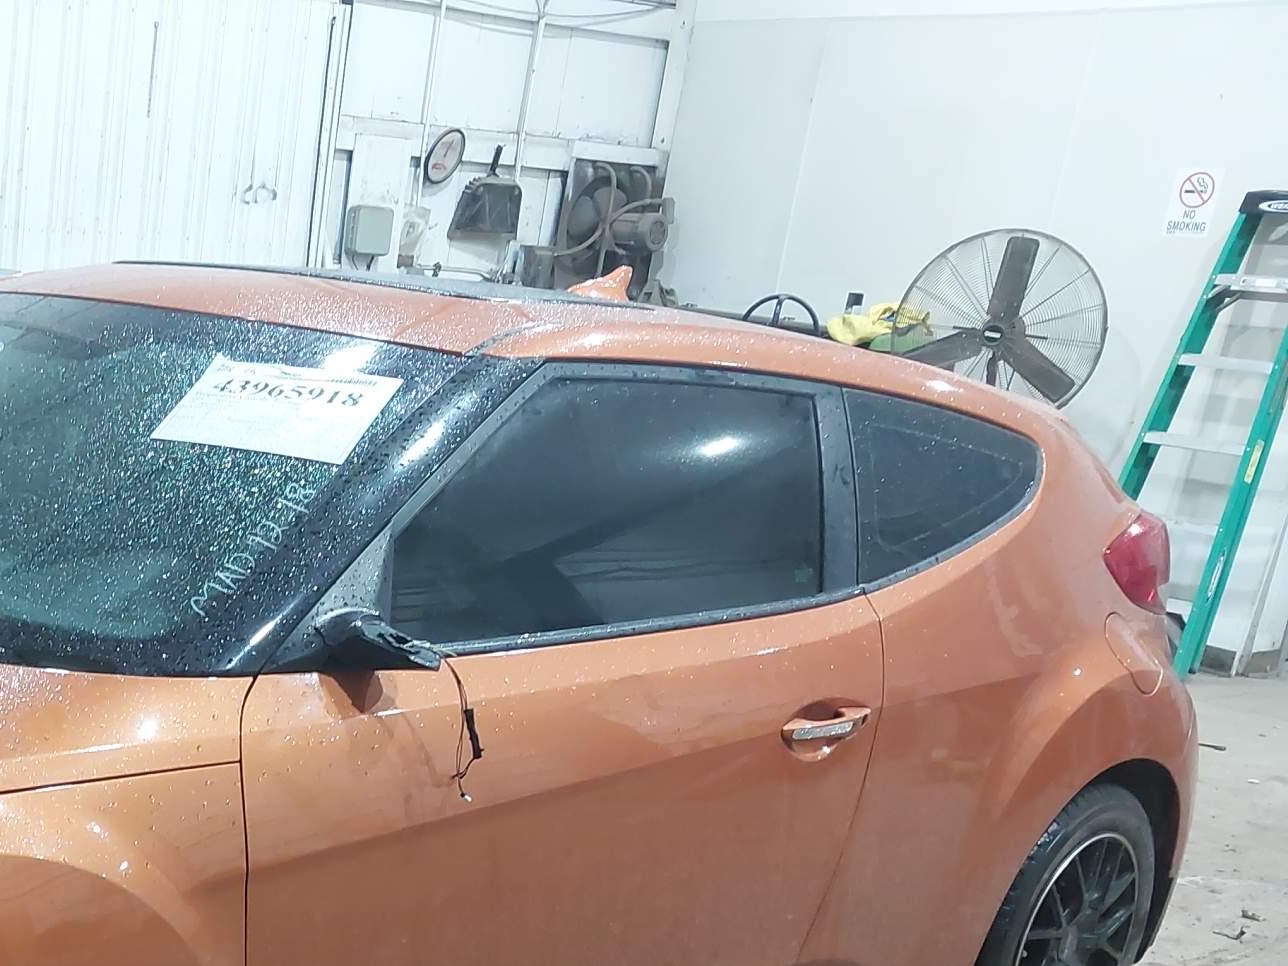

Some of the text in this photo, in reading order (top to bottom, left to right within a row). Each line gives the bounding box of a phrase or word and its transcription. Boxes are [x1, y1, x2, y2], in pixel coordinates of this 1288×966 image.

[1183, 209, 1196, 220] NO
[1166, 220, 1207, 232] SMOKING
[213, 377, 365, 407] 43965918
